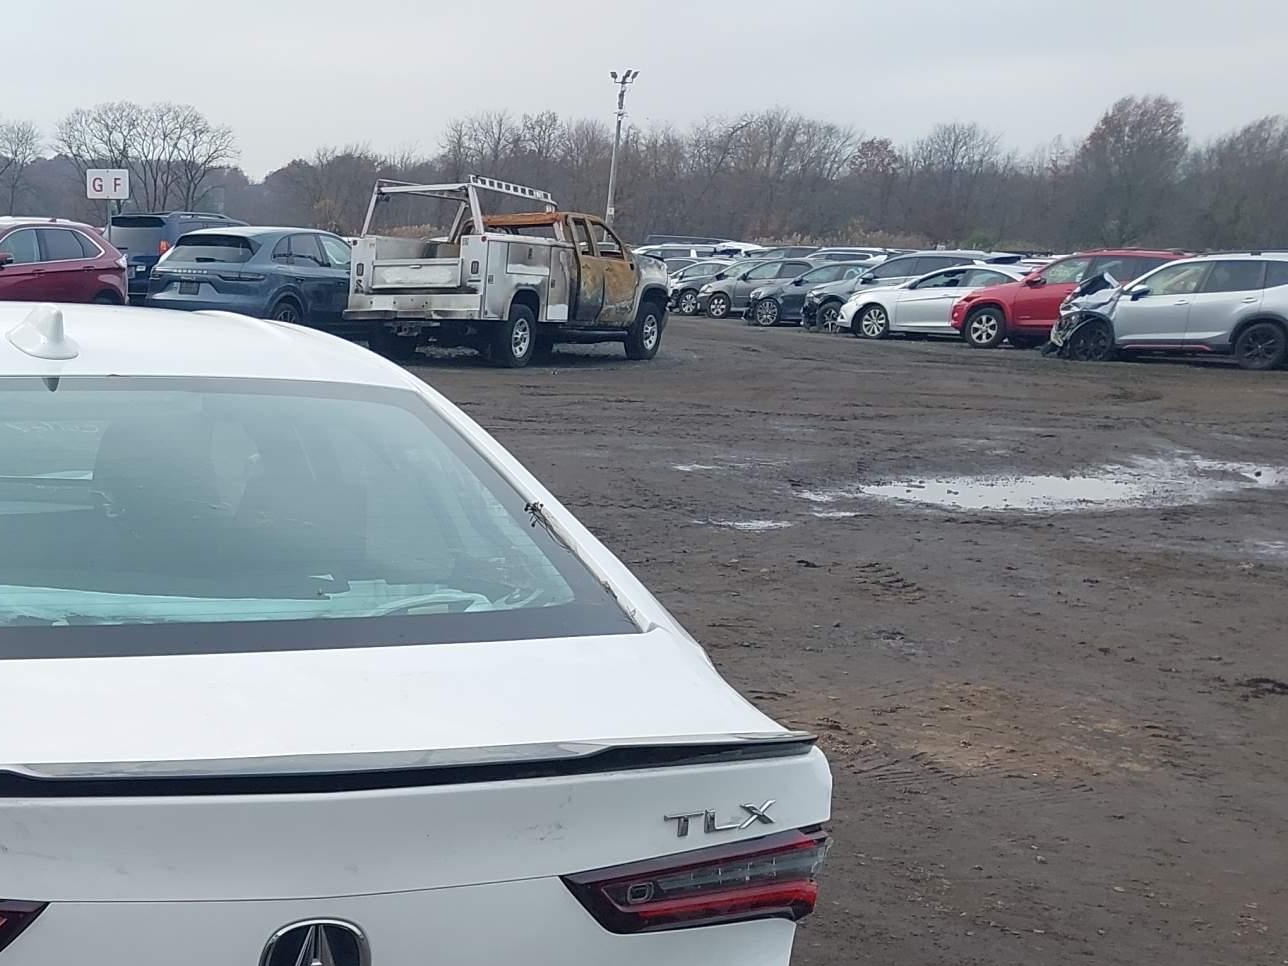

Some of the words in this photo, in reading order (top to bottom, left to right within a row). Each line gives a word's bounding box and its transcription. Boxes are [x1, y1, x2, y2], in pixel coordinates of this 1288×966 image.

[92, 177, 103, 192] G
[113, 177, 121, 192] F
[663, 799, 777, 838] TLX
